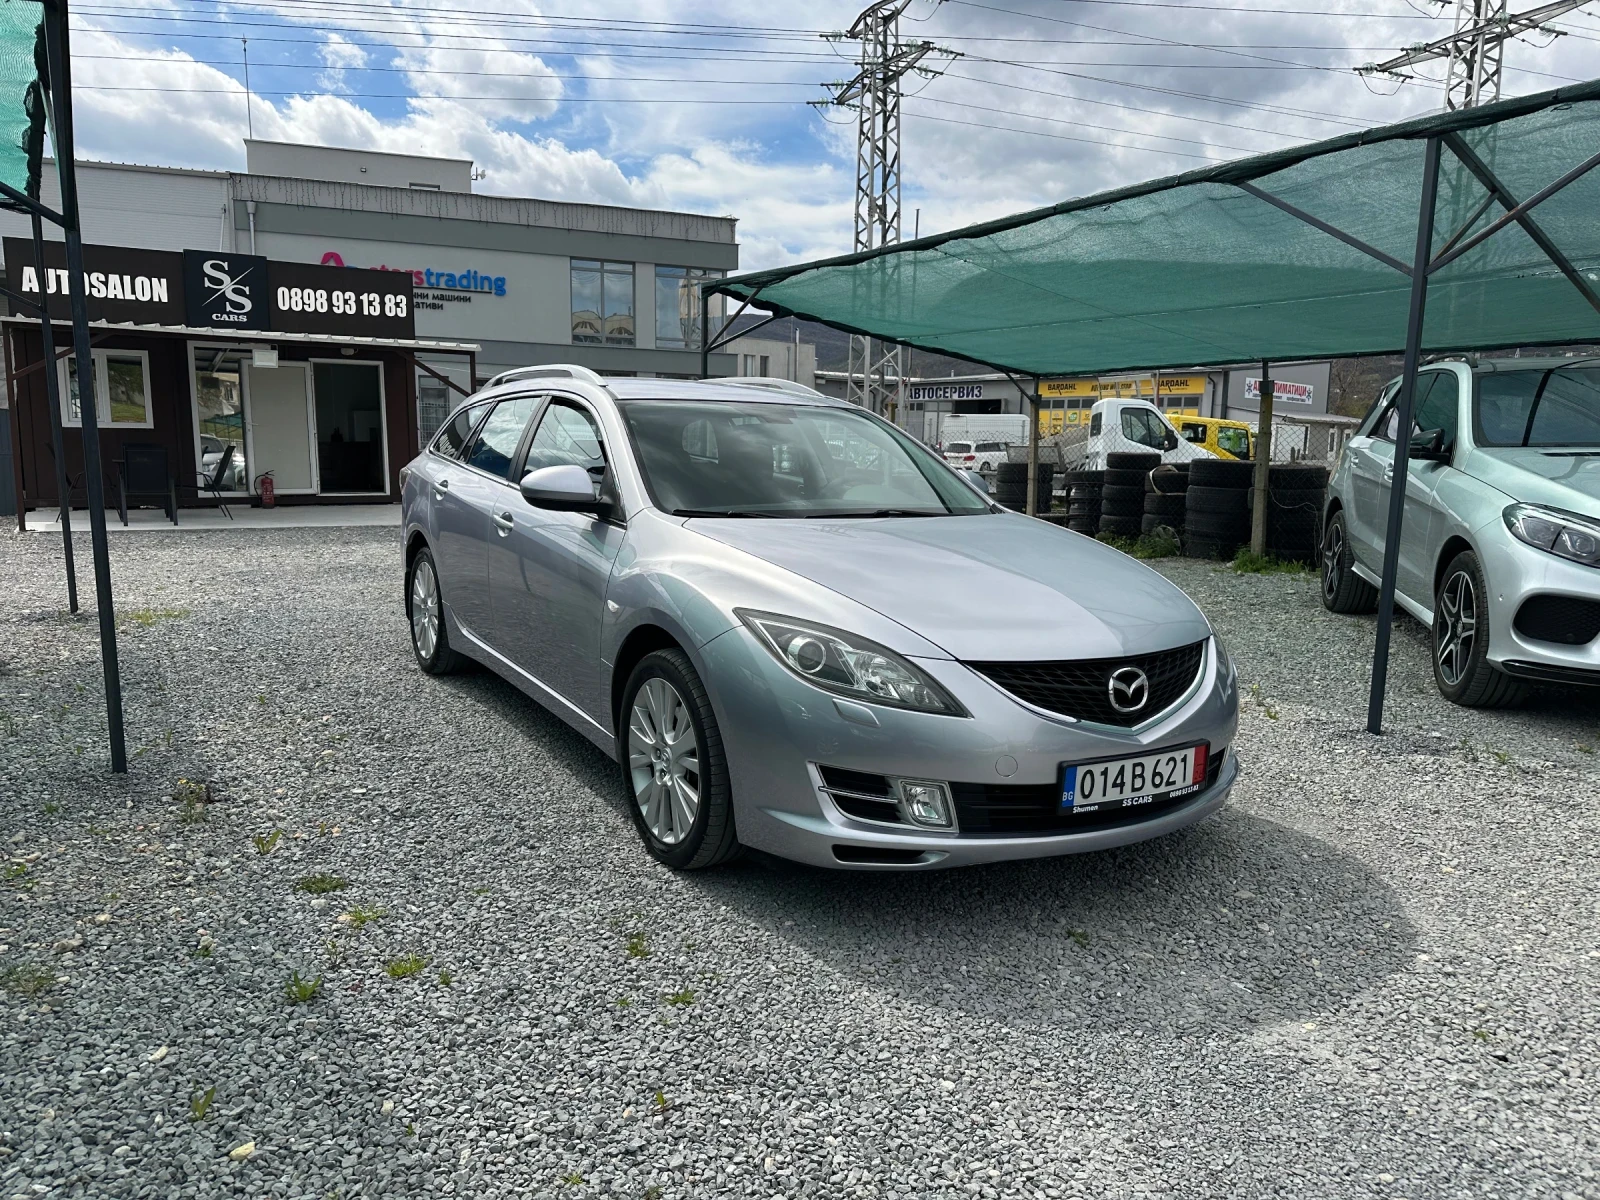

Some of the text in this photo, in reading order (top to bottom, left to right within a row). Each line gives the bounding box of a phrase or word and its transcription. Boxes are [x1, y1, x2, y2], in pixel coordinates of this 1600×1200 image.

[277, 286, 407, 318] 0898 93 13 83
[432, 293, 472, 303] машини
[413, 301, 444, 310] ативи
[212, 313, 247, 322] CARS
[1047, 383, 1077, 395] BARDAHL
[1062, 791, 1074, 801] BG
[1122, 795, 1153, 807] SS CARS
[1072, 805, 1099, 814] Shumen
